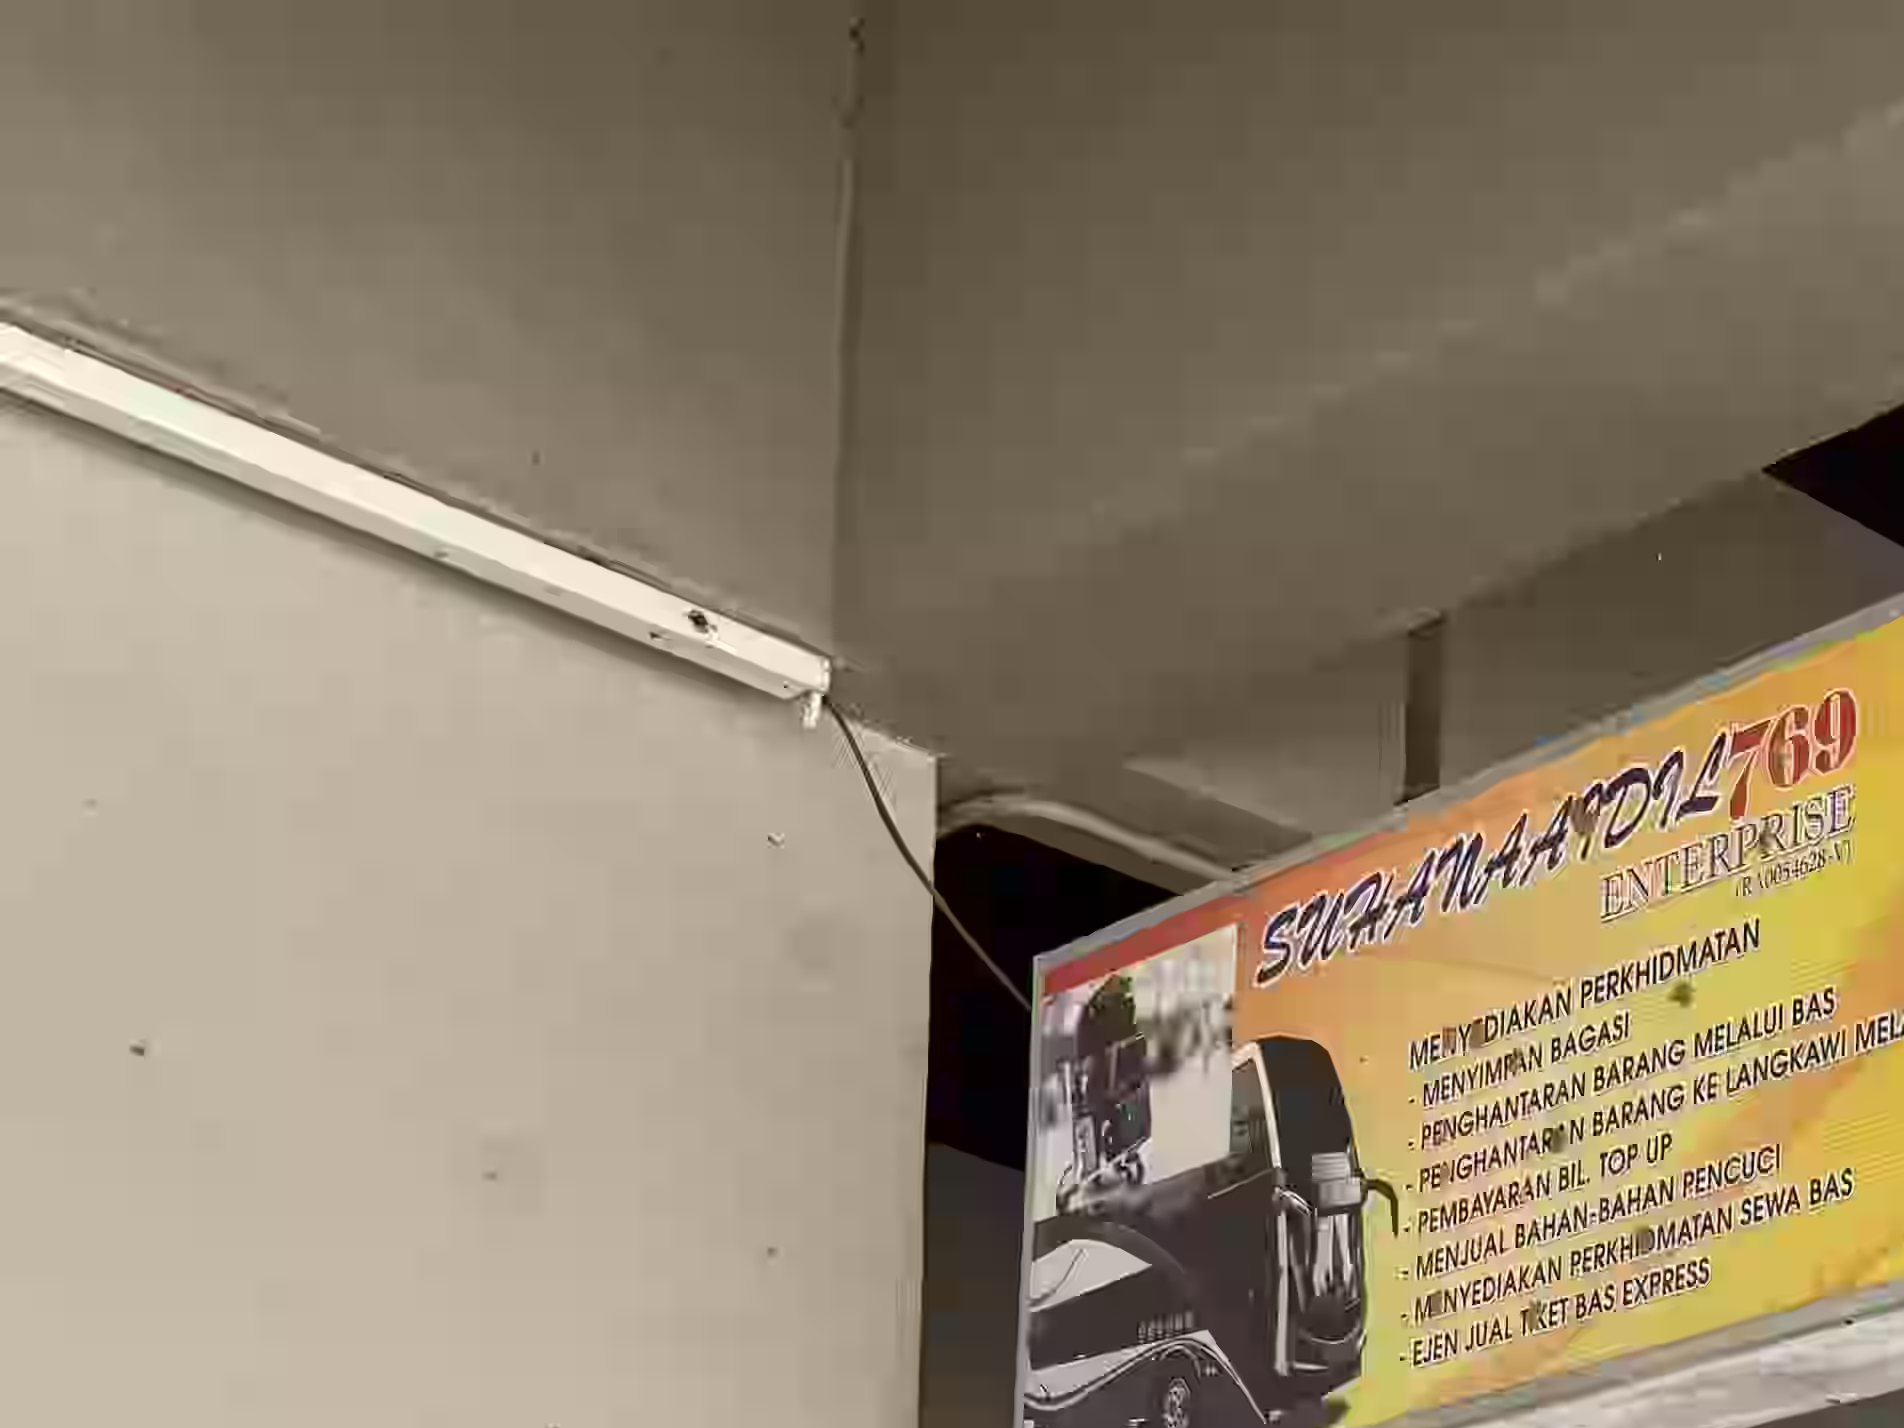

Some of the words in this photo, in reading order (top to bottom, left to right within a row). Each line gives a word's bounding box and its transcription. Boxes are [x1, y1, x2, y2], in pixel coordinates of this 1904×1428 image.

[1728, 688, 1857, 820] 769
[1599, 785, 1857, 919] ENTERPRISE
[1409, 984, 1572, 1070] MENYDIAKAN
[1580, 917, 1760, 1009] PERKHIDMATAN
[1422, 1041, 1543, 1107] MENYIMPAN
[1551, 1011, 1631, 1063] BAGASI
[1418, 1116, 1585, 1193] PEGHANTARN
[1591, 1084, 1685, 1137] BARANG
[1693, 1072, 1717, 1105] KE
[1725, 1029, 1847, 1094] LANGKAWI
[1420, 1072, 1586, 1151] PENGHANTARAN
[1592, 1039, 1686, 1093] BARANG
[1694, 1003, 1784, 1058] MELALUI
[1792, 986, 1836, 1025] BAS
[1413, 1255, 1562, 1325] MNYEDIAKAN
[1740, 1185, 1801, 1226] SEWA
[1809, 1168, 1855, 1205] BAS
[1415, 1227, 1509, 1281] MENJUAL
[1515, 1176, 1675, 1250] BAHAN-BAHAN
[1682, 1143, 1781, 1198] PENCUCI
[1417, 1171, 1551, 1235] PEMBAYARAN
[1600, 1142, 1638, 1178] TOP
[1646, 1133, 1673, 1164] UP
[1411, 1332, 1458, 1367] EJEN
[1464, 1314, 1513, 1351] JUAL
[1520, 1297, 1569, 1337] TKET
[1575, 1284, 1615, 1319] BAS
[1621, 1257, 1712, 1306] EXPRESS
